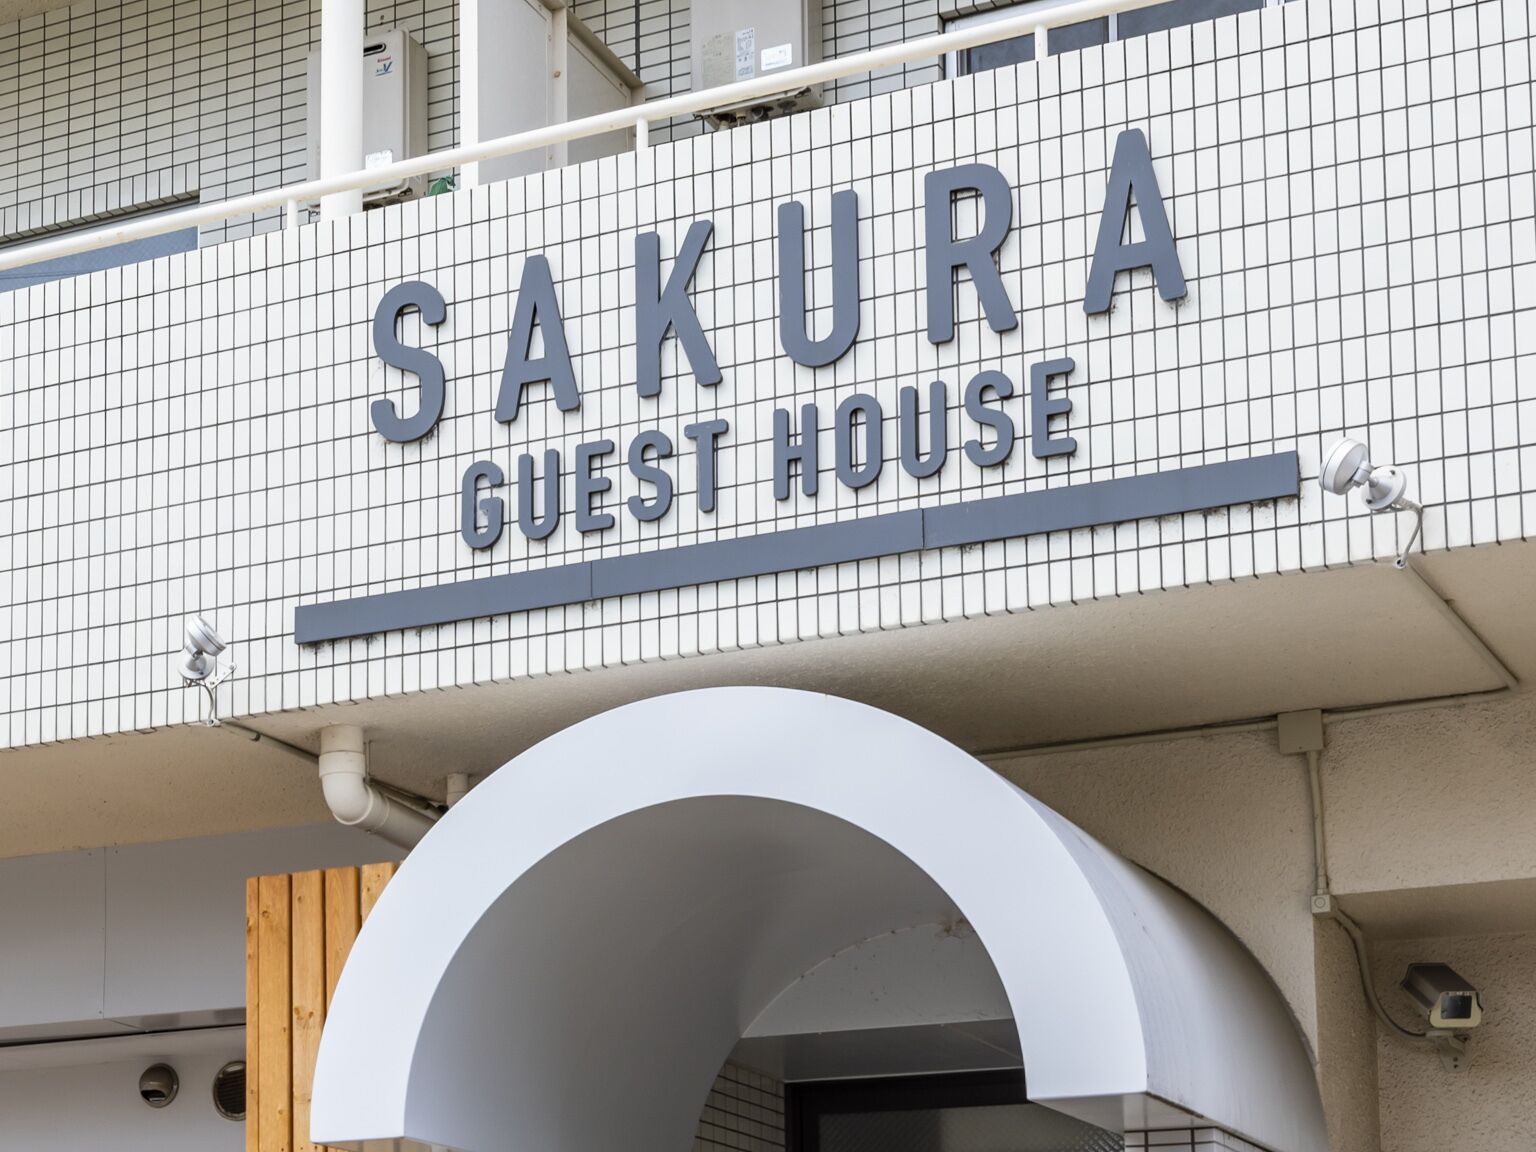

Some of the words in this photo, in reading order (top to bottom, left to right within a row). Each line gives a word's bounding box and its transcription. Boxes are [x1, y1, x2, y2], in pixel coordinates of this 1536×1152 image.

[370, 128, 1188, 444] SAKURA
[460, 417, 729, 551] GUEST
[770, 356, 1078, 502] HOUSE
